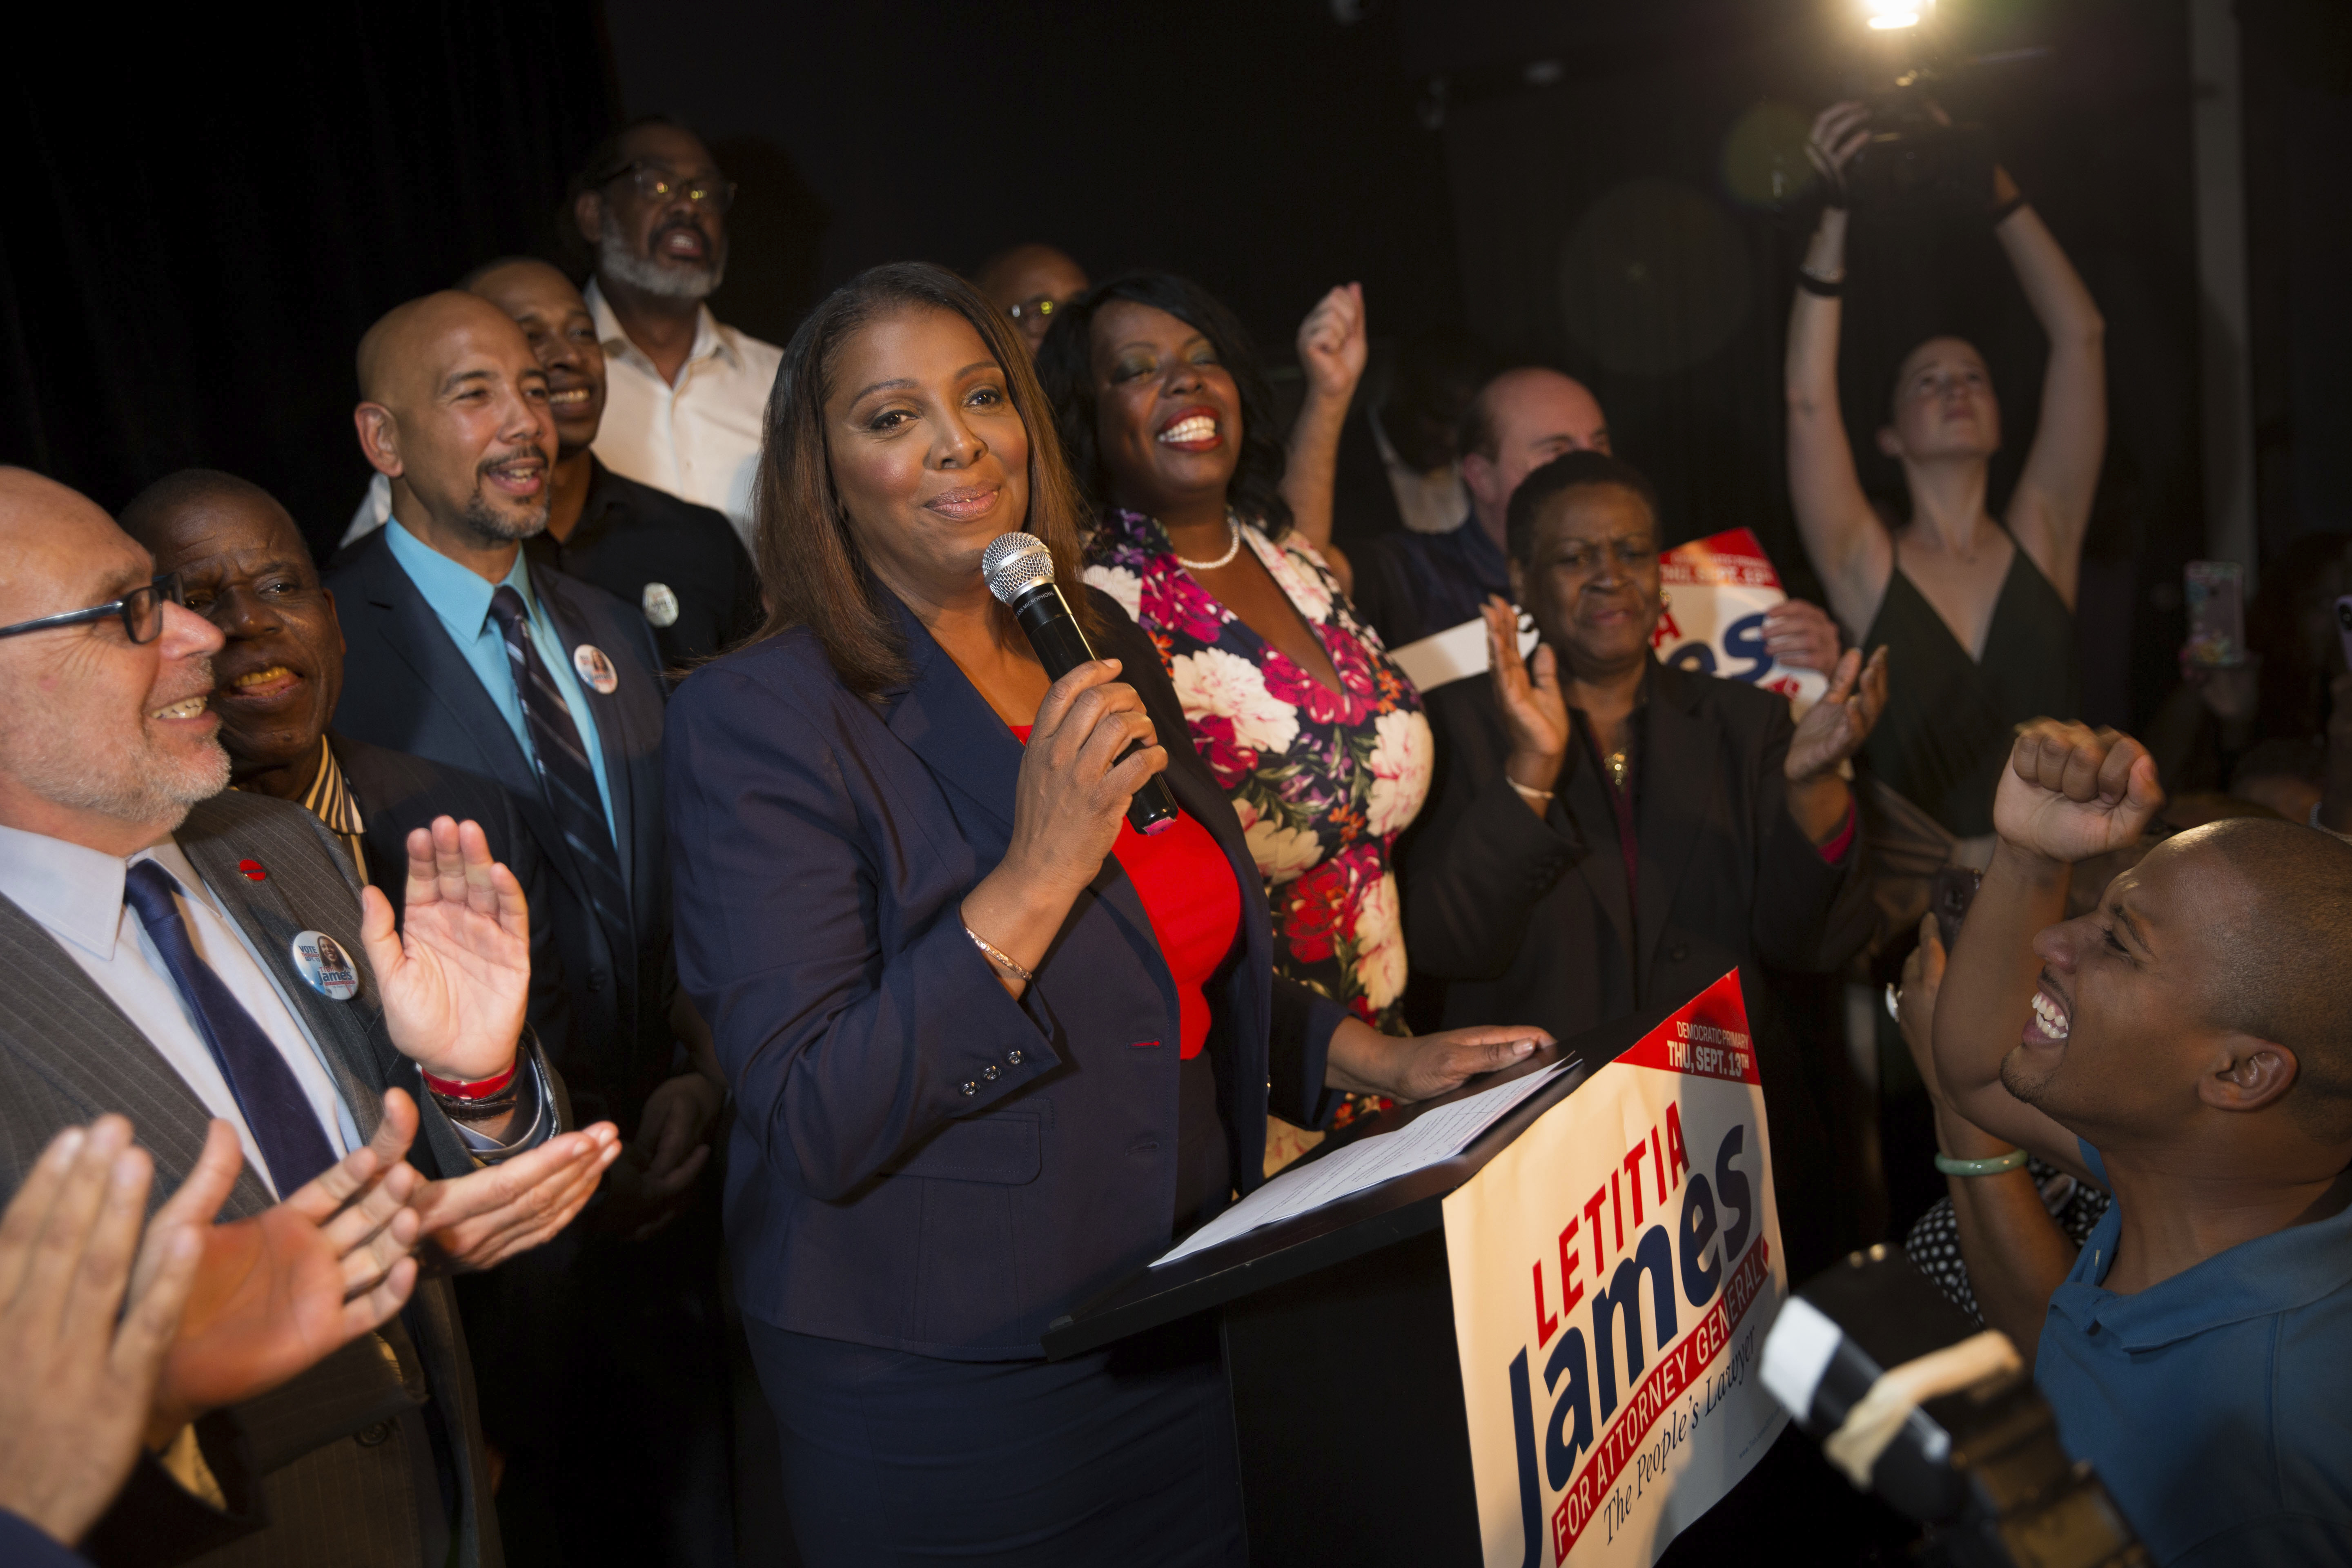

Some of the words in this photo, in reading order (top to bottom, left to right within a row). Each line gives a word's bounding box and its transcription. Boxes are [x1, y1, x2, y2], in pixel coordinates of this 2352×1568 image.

[1023, 591, 1055, 609] MICROPHONE
[317, 971, 353, 985] James
[1676, 1021, 1722, 1045] DEMOCRATIC
[1722, 1030, 1749, 1050] PRIMARY
[1667, 1040, 1694, 1074] THU,
[1695, 1046, 1727, 1075] SEPT.
[1728, 1051, 1750, 1077] 13TH
[1532, 1100, 1690, 1351] LETITIA
[1509, 1124, 1751, 1568] James
[1556, 1475, 1591, 1555] FOR
[1597, 1344, 1688, 1497] ATTORNEY
[1696, 1252, 1761, 1365] GENERAL
[1604, 1484, 1632, 1546] The
[1637, 1394, 1699, 1500] People's
[1705, 1325, 1755, 1417] Lawyer
